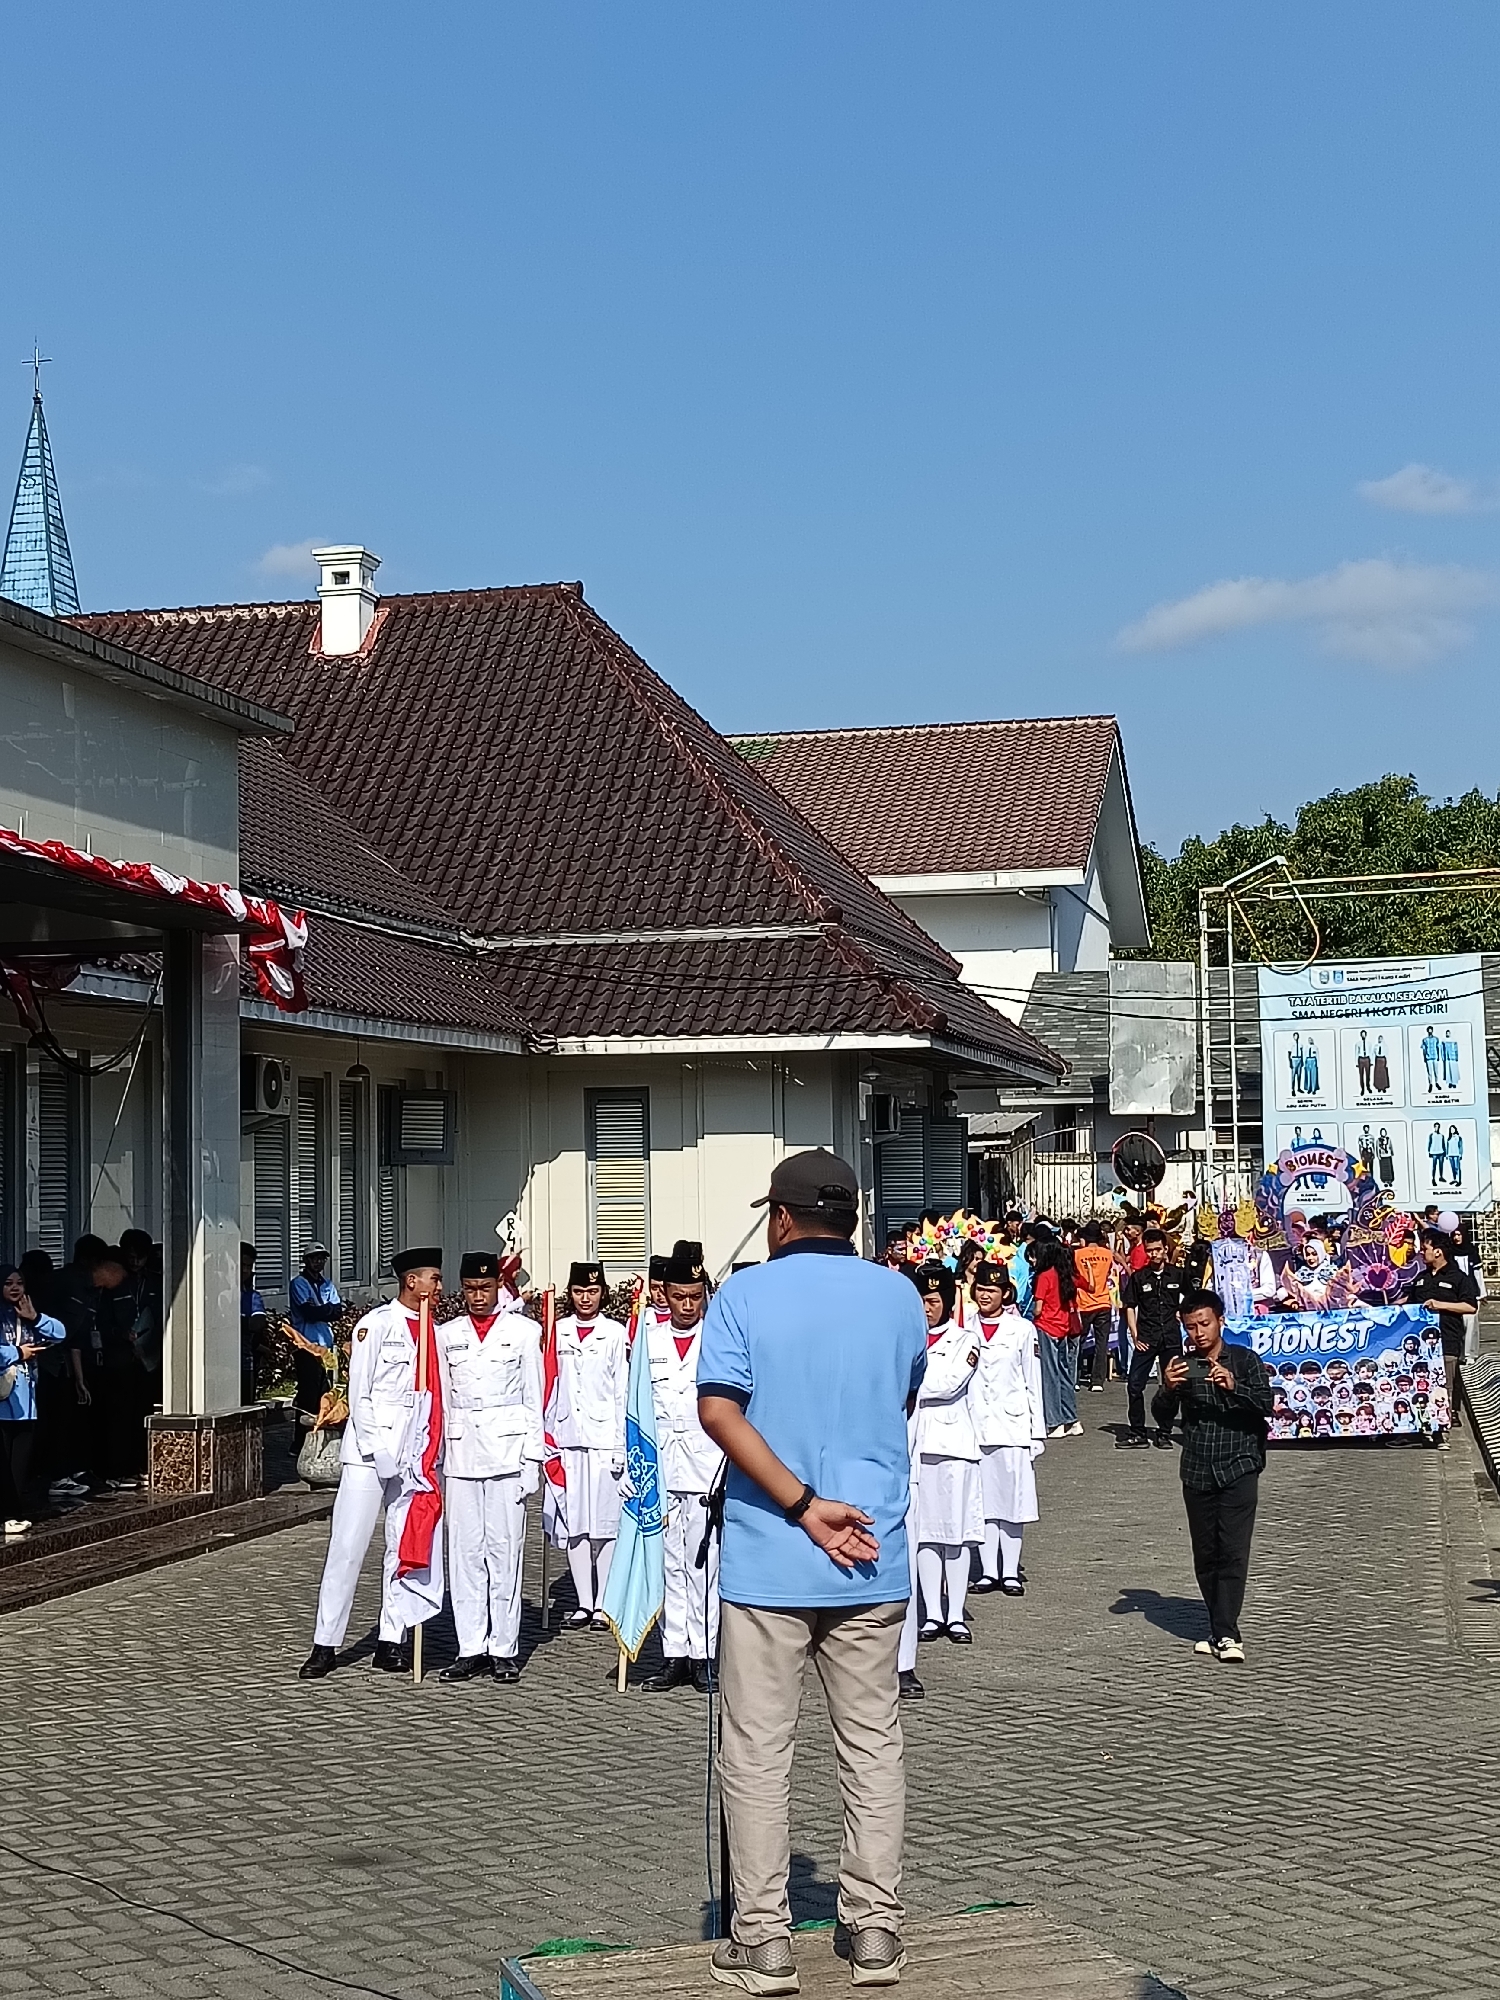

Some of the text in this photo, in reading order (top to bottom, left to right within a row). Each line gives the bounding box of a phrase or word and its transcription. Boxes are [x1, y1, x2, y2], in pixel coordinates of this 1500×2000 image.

[1288, 988, 1448, 1007] TATA TERTIB PAKAIAN SERAGAM
[1291, 1010, 1316, 1019] SMA
[1320, 1008, 1361, 1019] NEGERI
[1372, 1006, 1407, 1017] KOTA
[1409, 1003, 1448, 1016] KEDIRI
[1285, 1153, 1344, 1172] BIONEST
